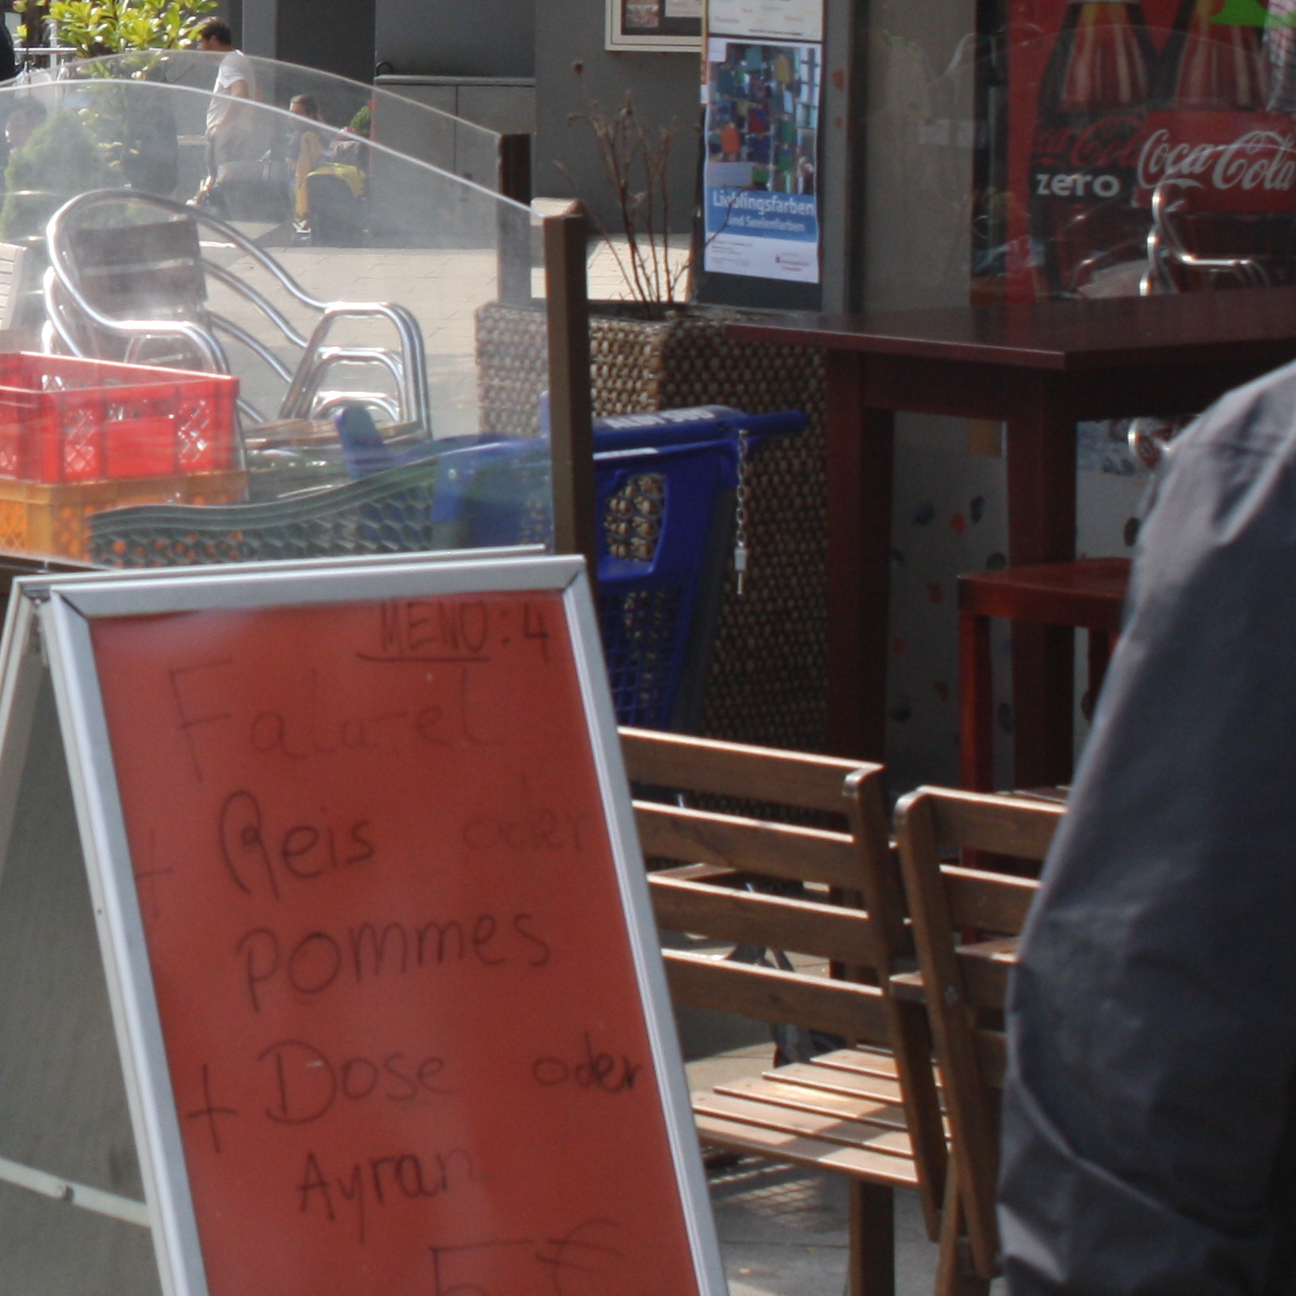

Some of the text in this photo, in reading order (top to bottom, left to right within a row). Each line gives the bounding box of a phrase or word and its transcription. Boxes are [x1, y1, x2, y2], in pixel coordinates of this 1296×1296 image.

[1036, 172, 1121, 199] zero
[522, 602, 551, 664] 4
[219, 790, 375, 901] Reis
[186, 1030, 644, 1153] + Dose oder
[298, 1144, 478, 1244] Ayran
